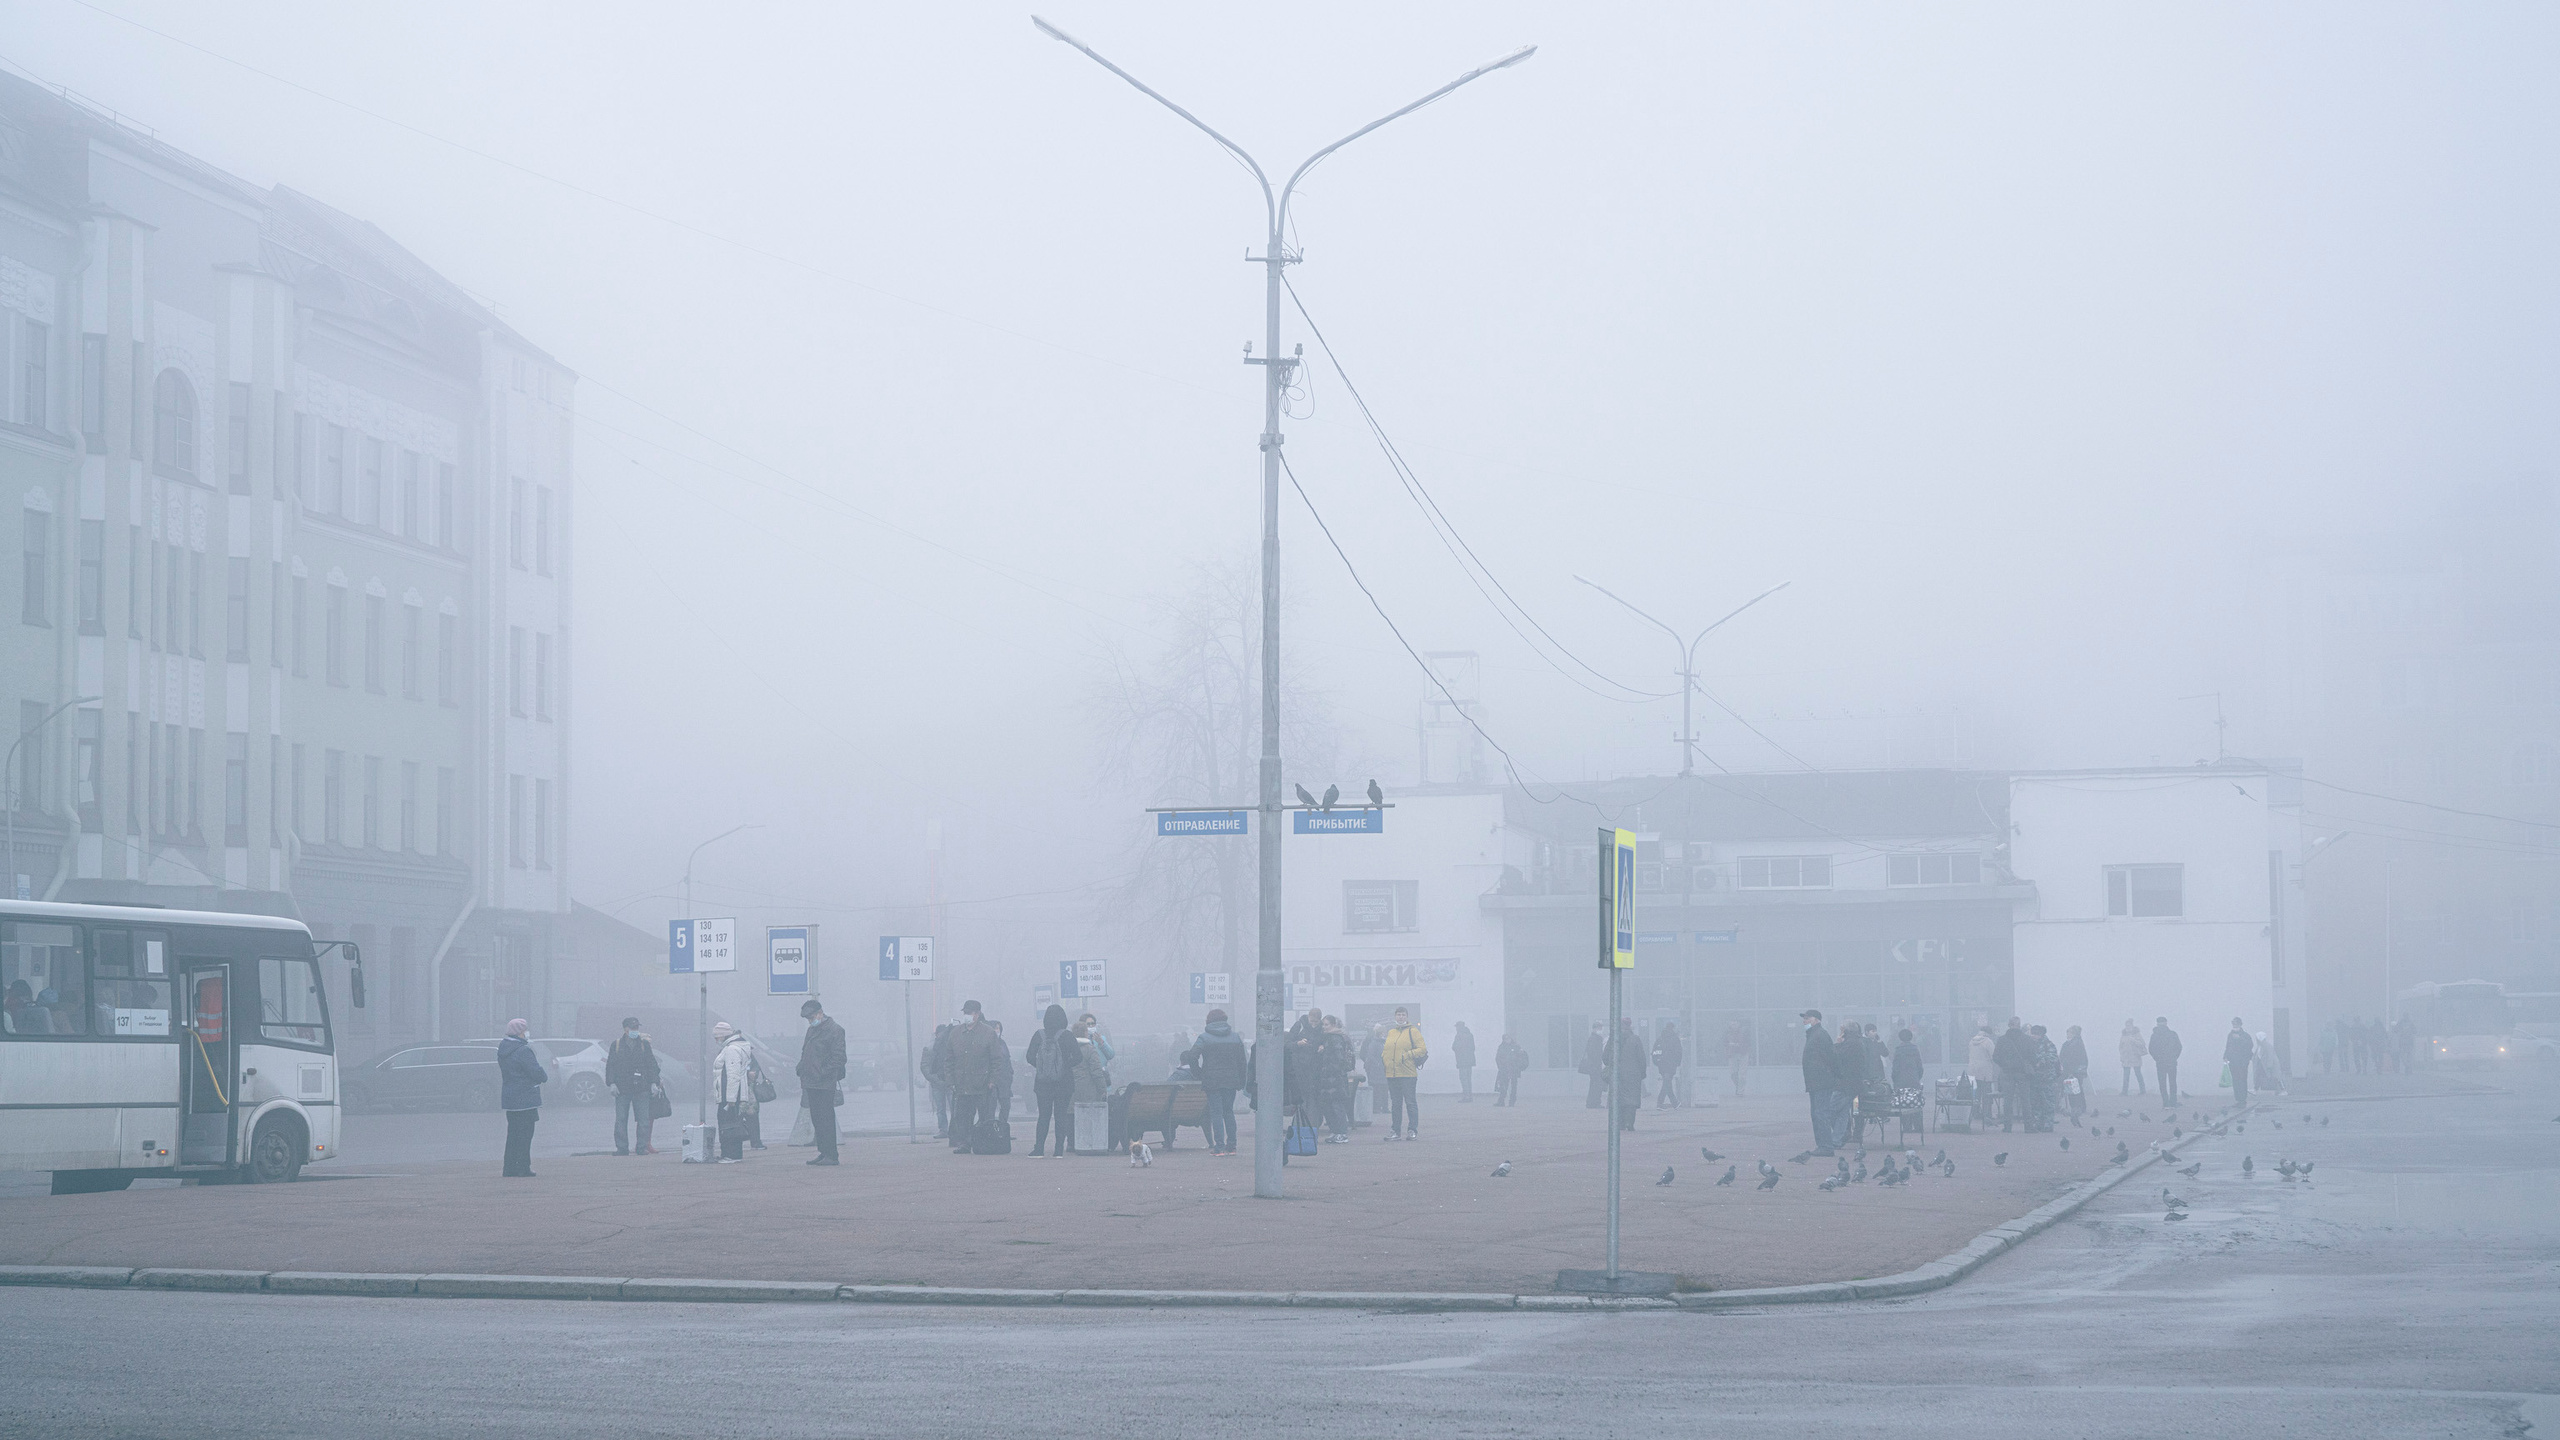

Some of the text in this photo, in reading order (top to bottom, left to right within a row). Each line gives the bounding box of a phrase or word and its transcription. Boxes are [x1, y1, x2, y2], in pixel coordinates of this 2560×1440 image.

[1164, 819, 1241, 831] ОТПРАВЛЕНИЕ
[1308, 818, 1368, 830] ПРИБЫТИЕ
[700, 921, 712, 930] 130
[676, 927, 686, 949] 5
[700, 933, 728, 943] 134 137
[885, 943, 895, 960] 4
[918, 943, 928, 951] 135
[700, 948, 728, 958] 146 147
[918, 955, 928, 963] 143
[911, 968, 921, 976] 139
[1065, 965, 1073, 980] 3
[1292, 964, 1416, 987] ПЫШКИ
[1195, 975, 1202, 989] 2
[116, 1016, 130, 1027] 137
